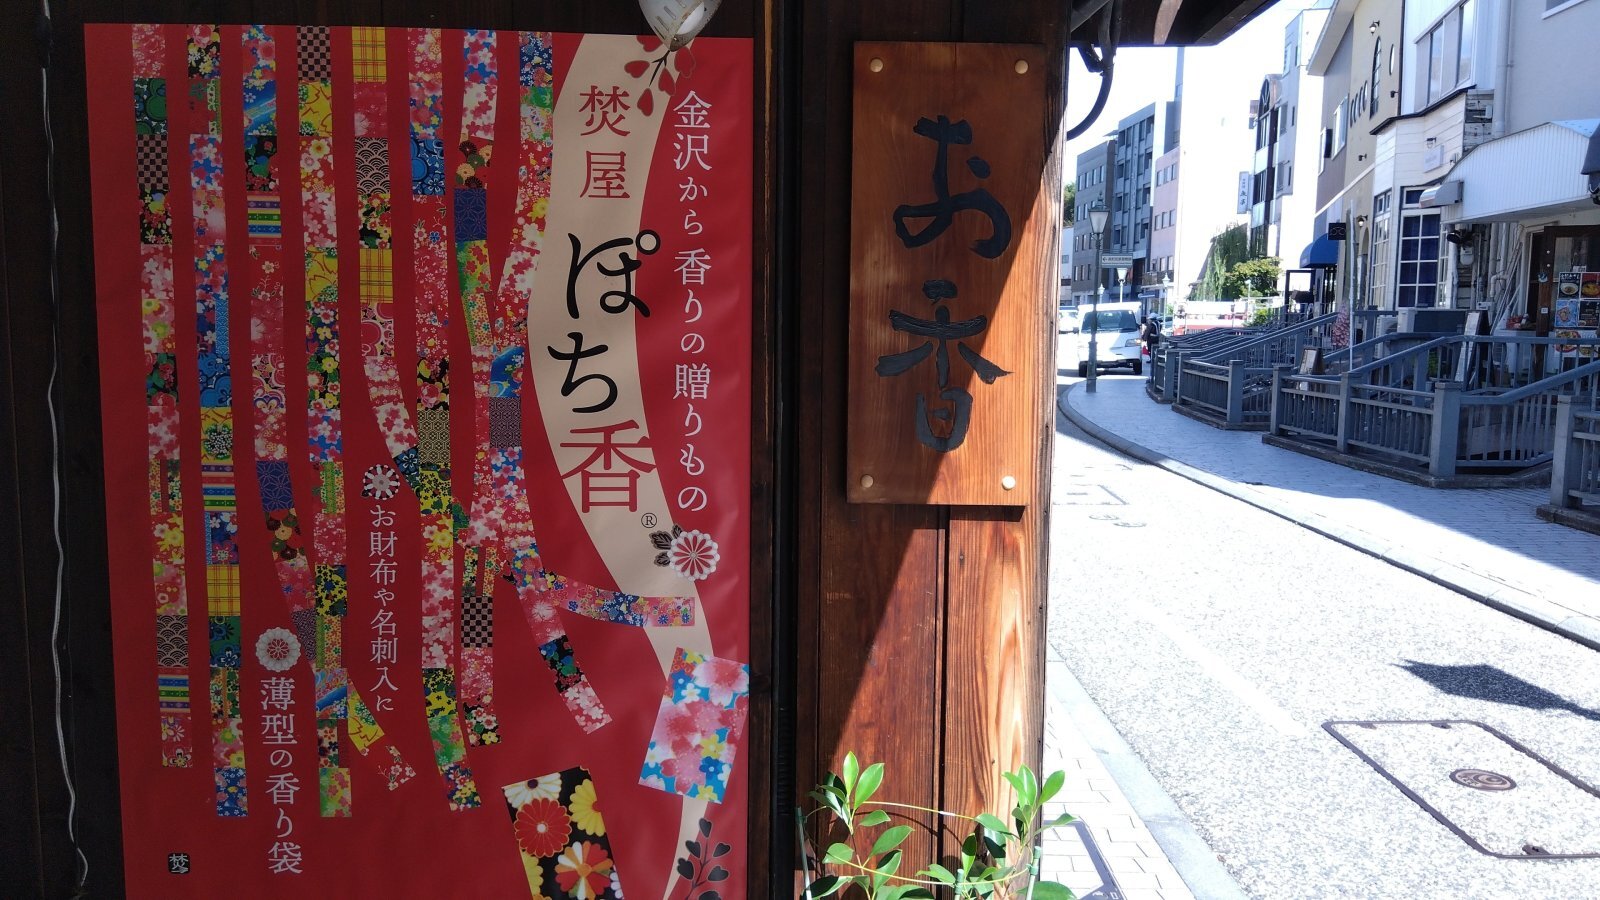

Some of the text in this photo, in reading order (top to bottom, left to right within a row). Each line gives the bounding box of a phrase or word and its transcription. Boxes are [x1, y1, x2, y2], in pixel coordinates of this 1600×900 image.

[672, 90, 713, 512] 金沢から香りの贈りもの
[874, 114, 1014, 453] お香
[368, 504, 399, 712] お財布や名刺入に
[260, 676, 303, 875] 薄型の香り袋
